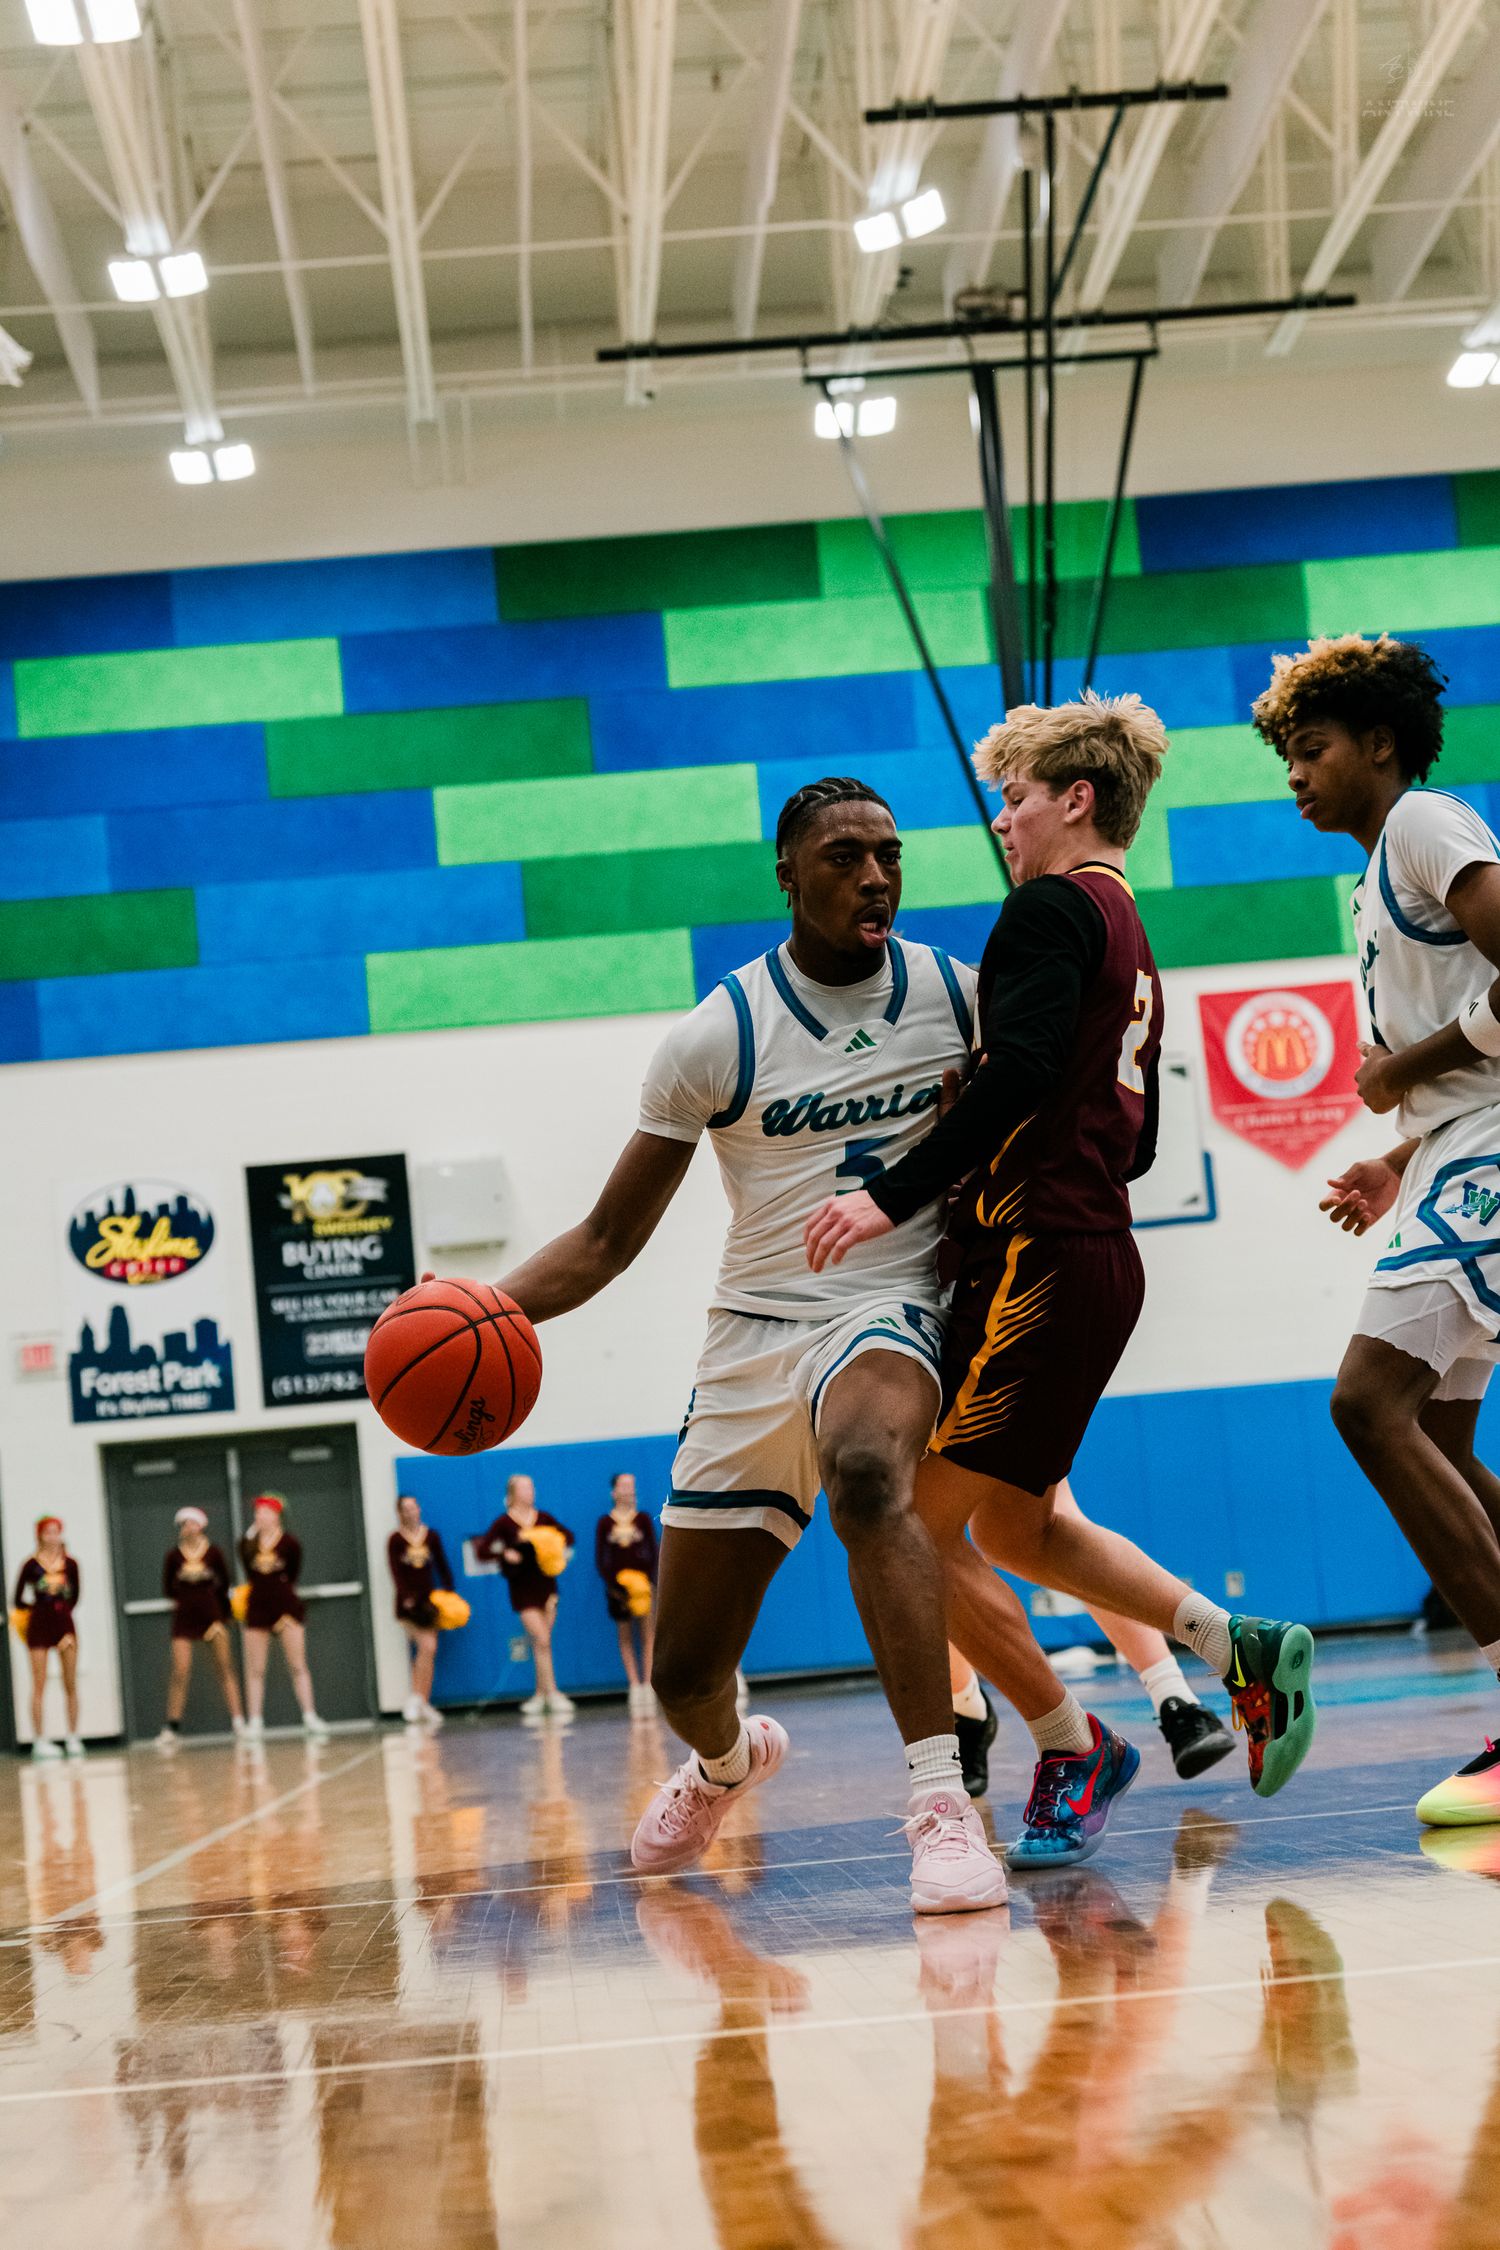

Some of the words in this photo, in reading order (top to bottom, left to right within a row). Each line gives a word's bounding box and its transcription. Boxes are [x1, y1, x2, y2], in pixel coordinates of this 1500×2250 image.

[761, 1083, 943, 1137] Warrio
[836, 1134, 899, 1197] 5
[282, 1235, 384, 1267] BUYING
[303, 1261, 364, 1280] CENTER
[80, 1364, 162, 1398] Forest
[162, 1359, 222, 1391] Park
